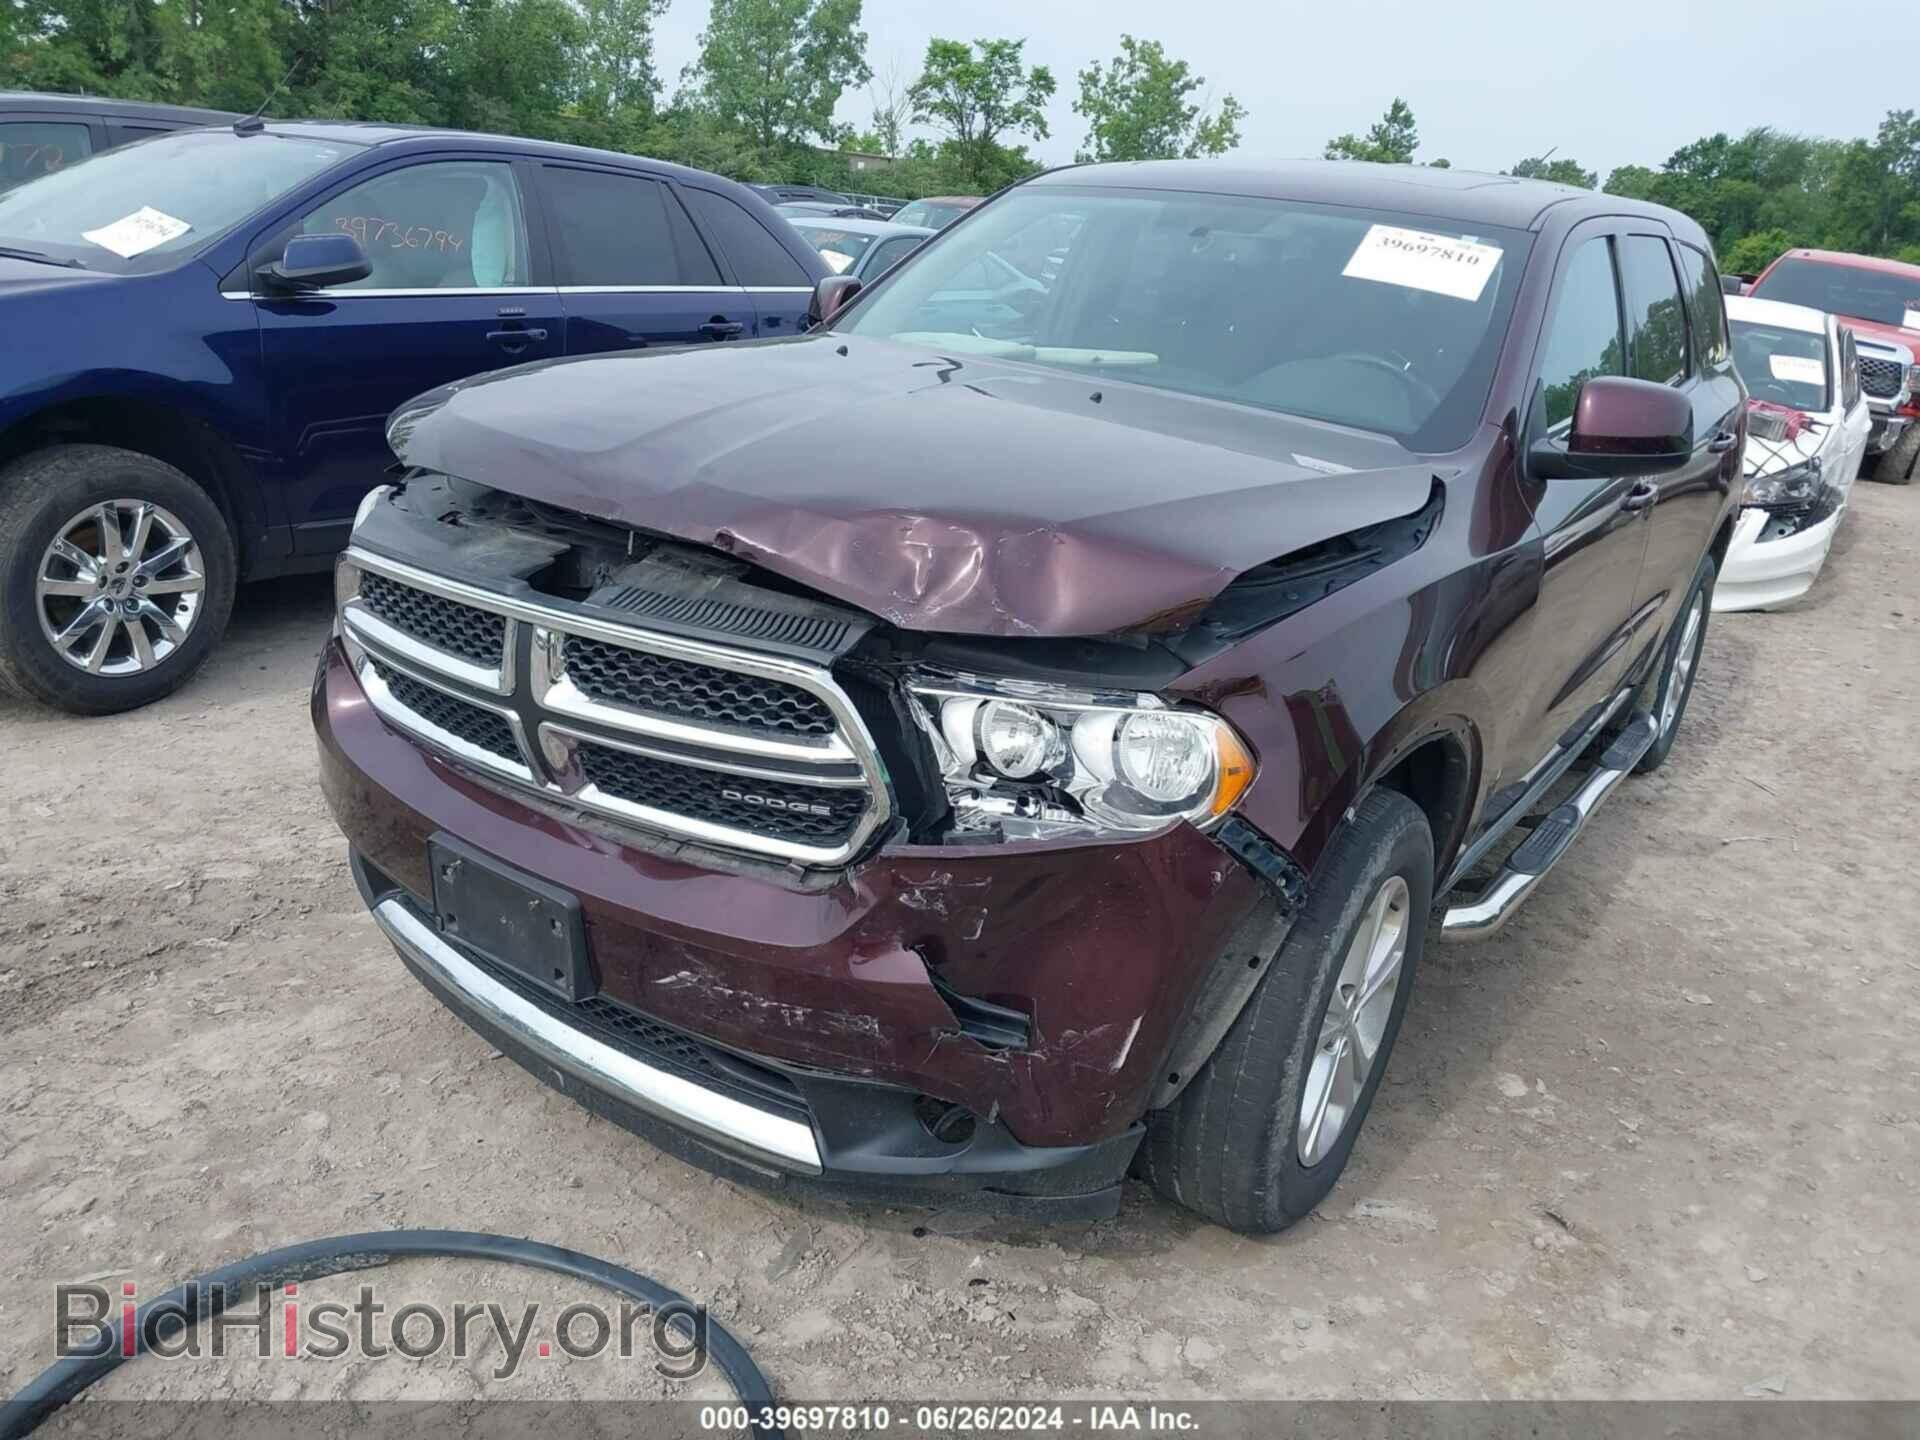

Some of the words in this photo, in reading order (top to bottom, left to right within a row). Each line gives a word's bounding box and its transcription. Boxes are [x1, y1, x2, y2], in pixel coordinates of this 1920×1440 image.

[336, 216, 464, 252] 39736794
[1376, 236, 1480, 265] 39697810
[722, 789, 831, 816] DODGE
